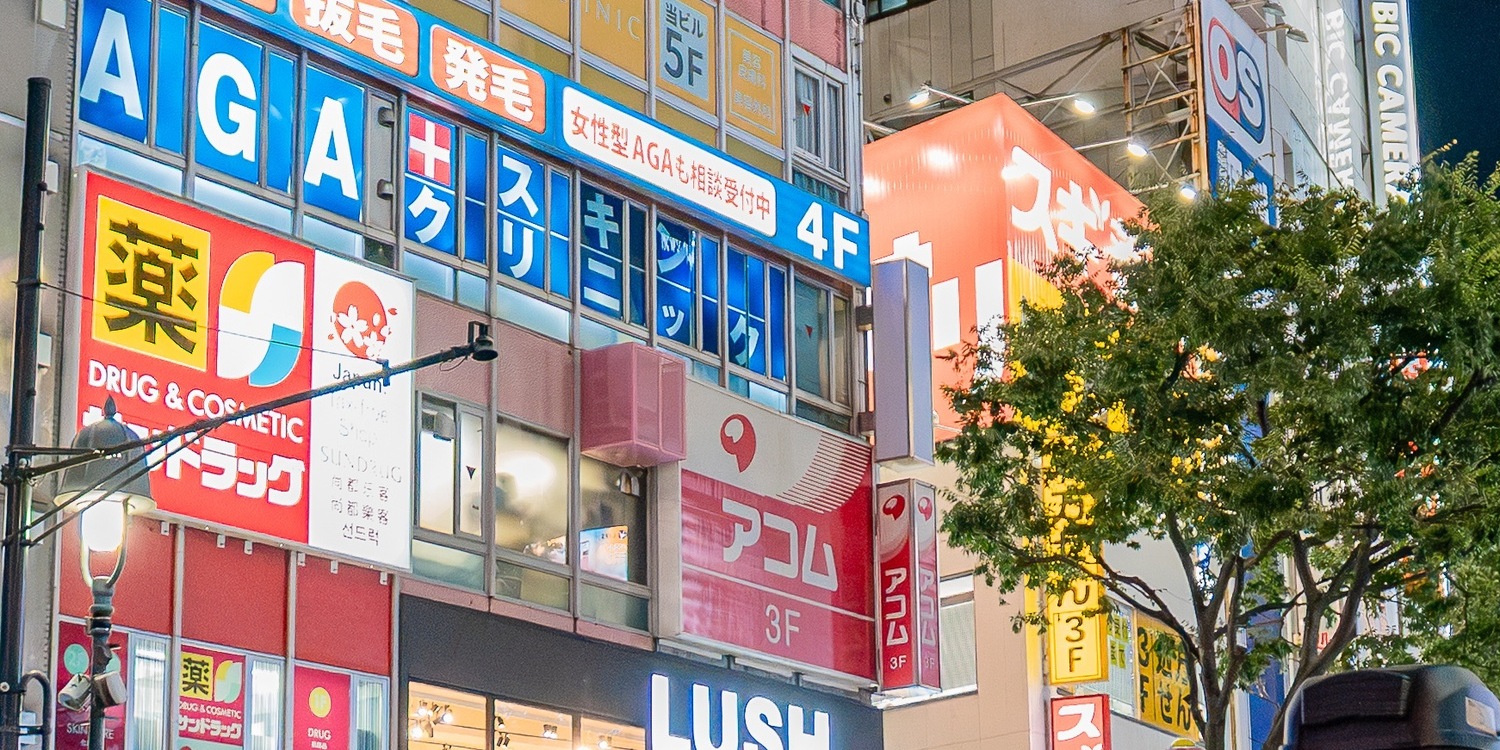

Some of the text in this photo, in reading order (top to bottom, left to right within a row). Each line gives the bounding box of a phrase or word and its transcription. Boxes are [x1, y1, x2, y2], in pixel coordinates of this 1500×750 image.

[301, 0, 406, 65] 抜毛
[664, 2, 704, 39] 当ビル
[1371, 2, 1402, 58] BIC
[443, 36, 534, 123] 発毛
[664, 27, 704, 87] 5F
[1209, 24, 1263, 128] OS
[80, 8, 360, 201] AGA
[796, 202, 860, 270] 4F
[104, 219, 199, 354] 薬
[88, 359, 304, 444] DRUG & COSMETIC
[722, 497, 838, 591] アコム
[765, 603, 801, 647] 3F
[885, 567, 909, 646] アコム
[919, 567, 936, 648] アコム
[182, 656, 209, 696] 薬
[890, 655, 907, 670] 3F
[924, 656, 935, 670] 3F
[1065, 616, 1085, 673] 3F
[206, 705, 242, 720] COSMETIC
[307, 727, 332, 741] DRUG
[652, 673, 830, 750] LUSH
